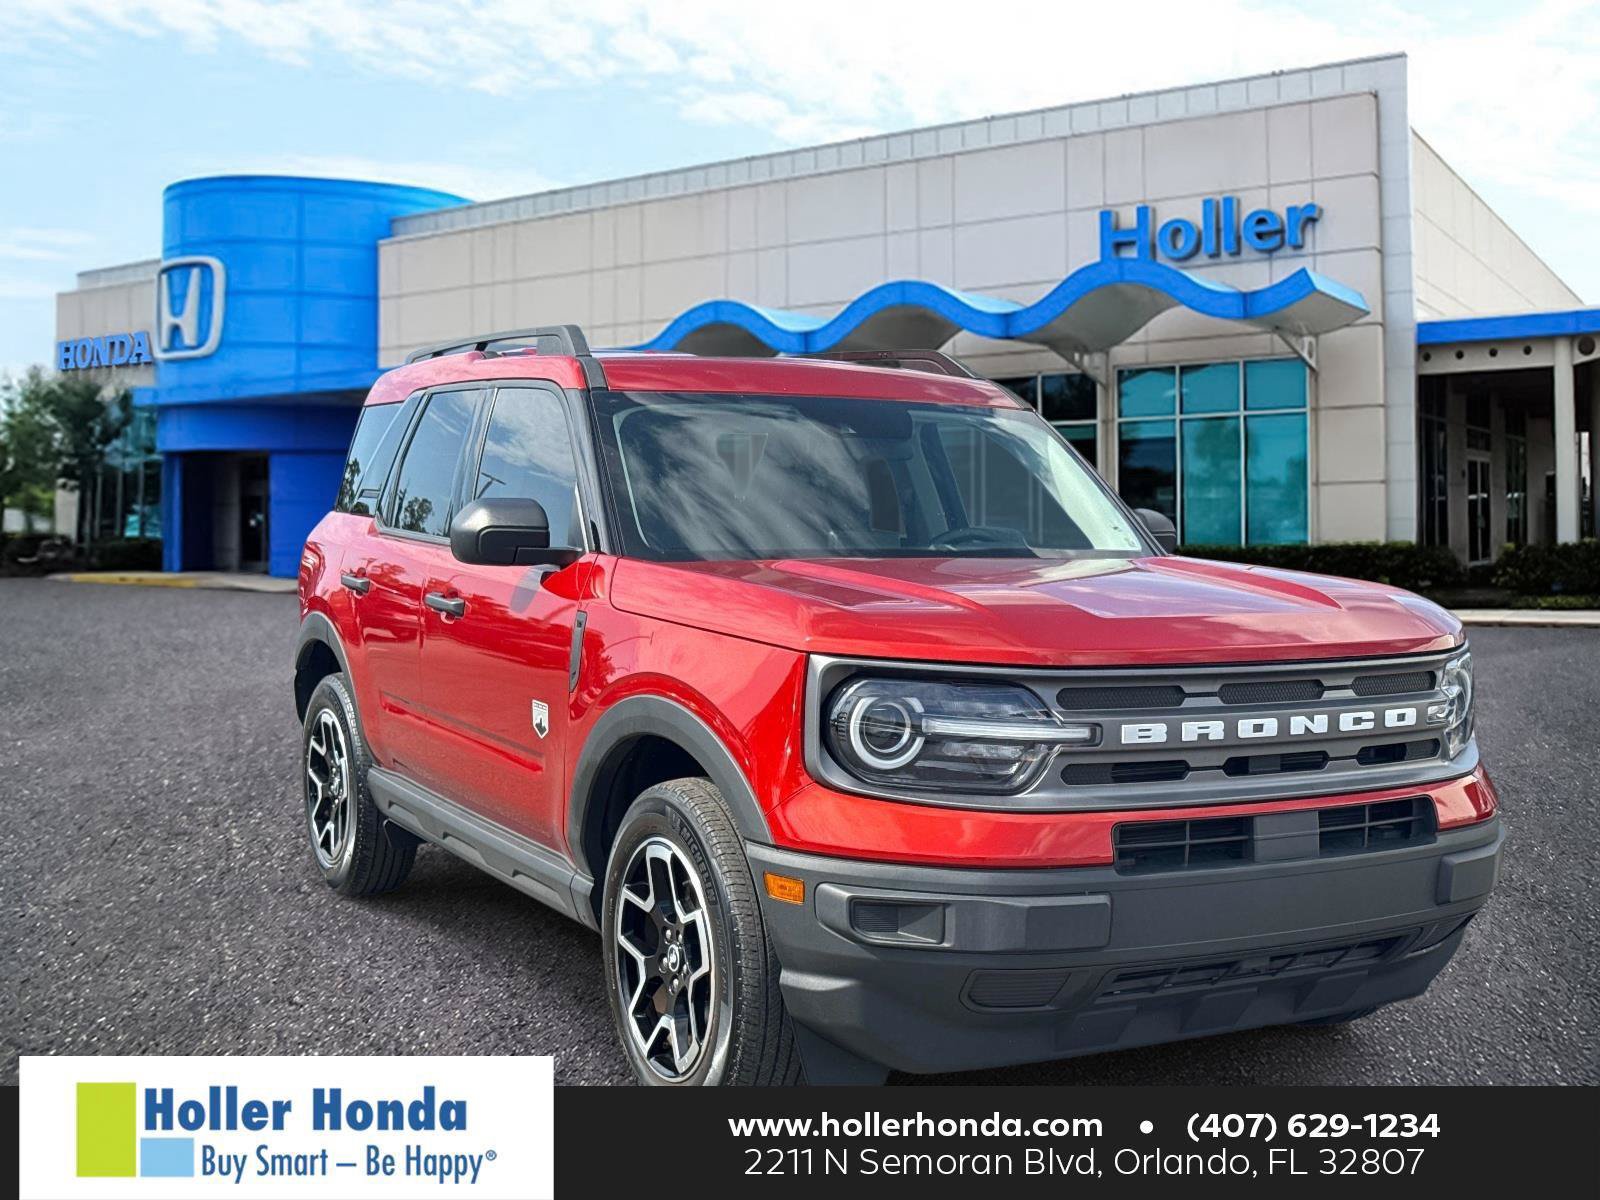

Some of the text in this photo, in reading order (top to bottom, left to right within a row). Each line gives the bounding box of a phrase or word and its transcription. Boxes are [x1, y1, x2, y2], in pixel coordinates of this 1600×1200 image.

[1099, 195, 1319, 262] Holler
[58, 330, 152, 371] HONDA
[1121, 707, 1417, 744] BRONCO
